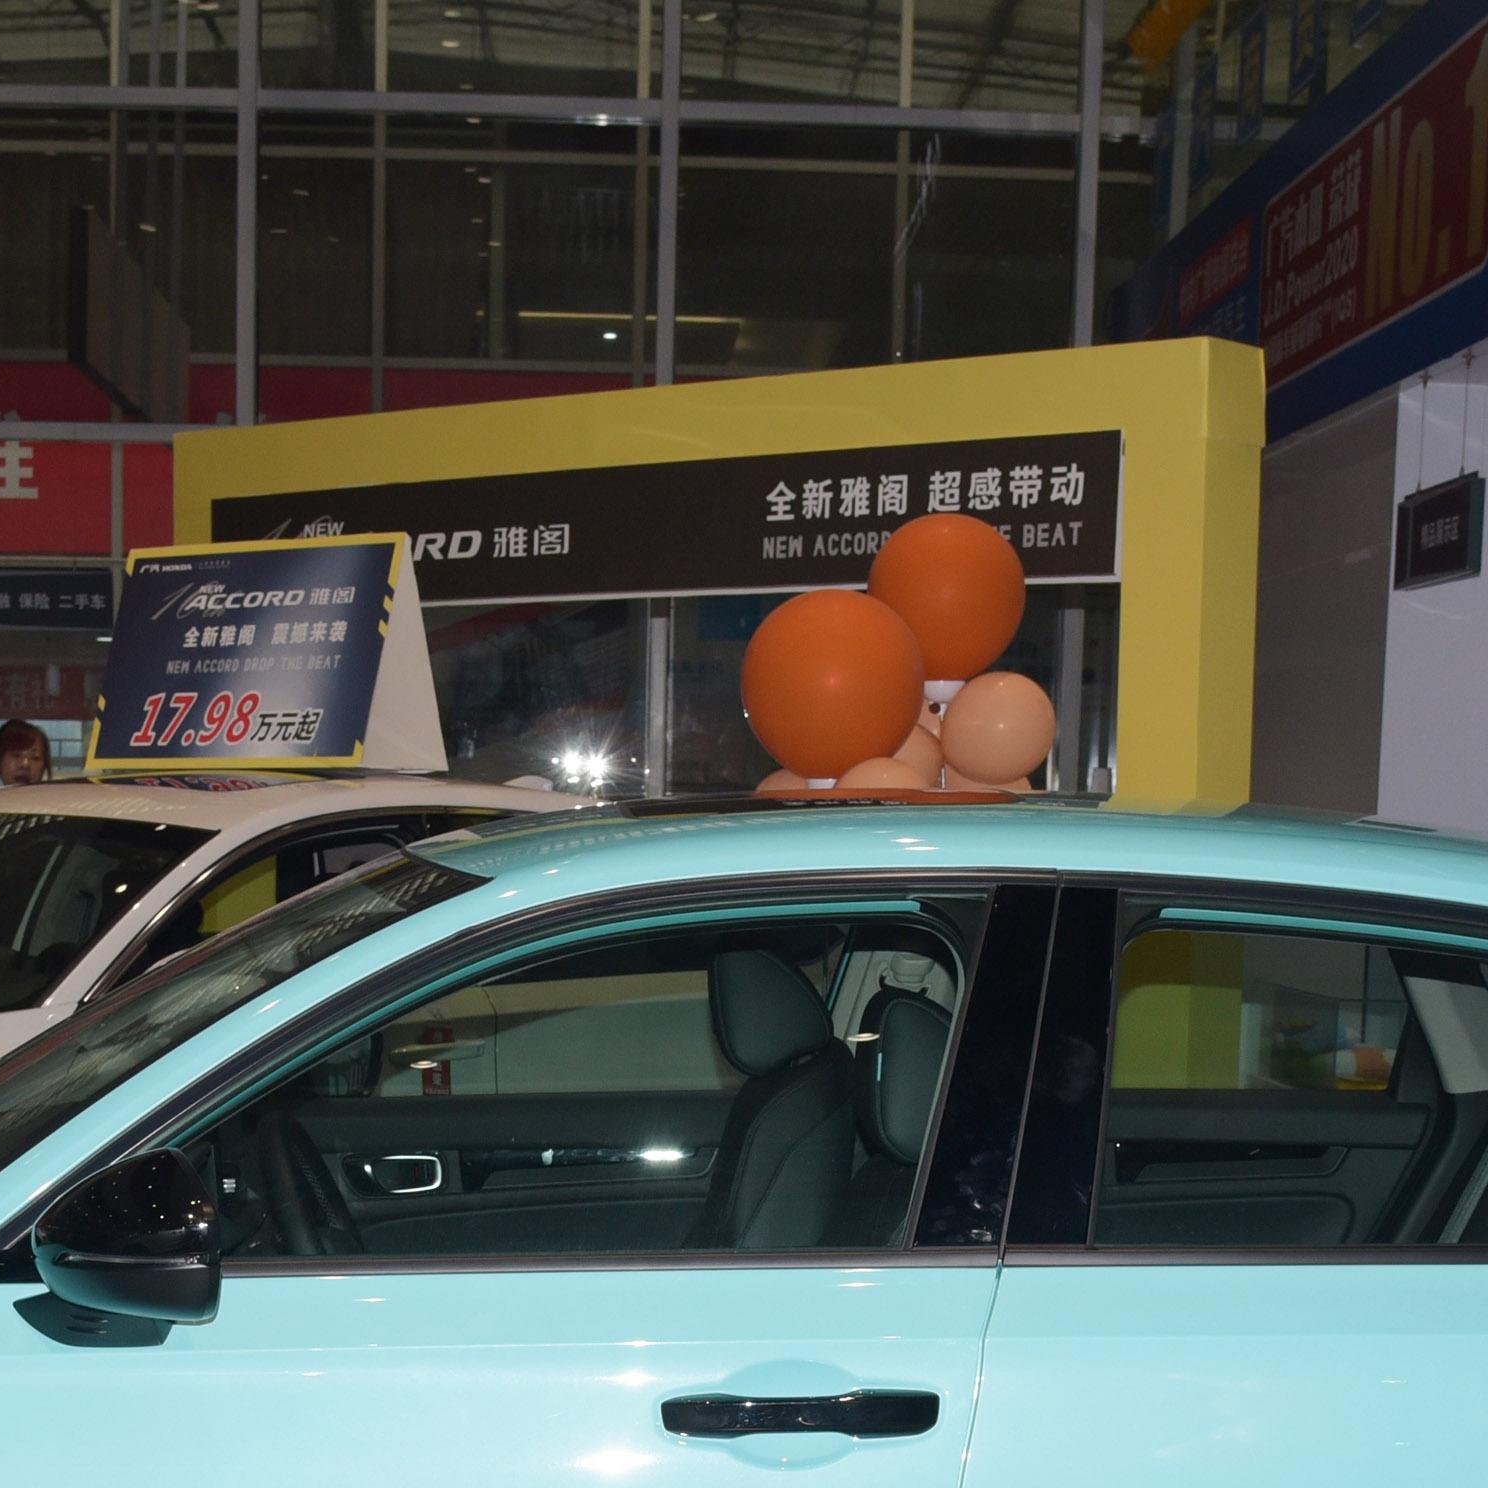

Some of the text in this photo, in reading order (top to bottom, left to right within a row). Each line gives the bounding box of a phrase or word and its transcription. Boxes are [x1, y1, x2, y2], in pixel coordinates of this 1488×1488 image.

[764, 462, 1086, 522] 全新雅阁 超感带动
[491, 523, 572, 559] 雅阁
[762, 535, 804, 560] NEW
[1021, 521, 1084, 549] BEAT
[58, 592, 107, 611] 二手车
[184, 588, 306, 611] ACCORD
[182, 624, 257, 648] 全新雅阁
[166, 659, 190, 675] NEW
[194, 657, 239, 674] ACCORD
[244, 656, 275, 673] DROP
